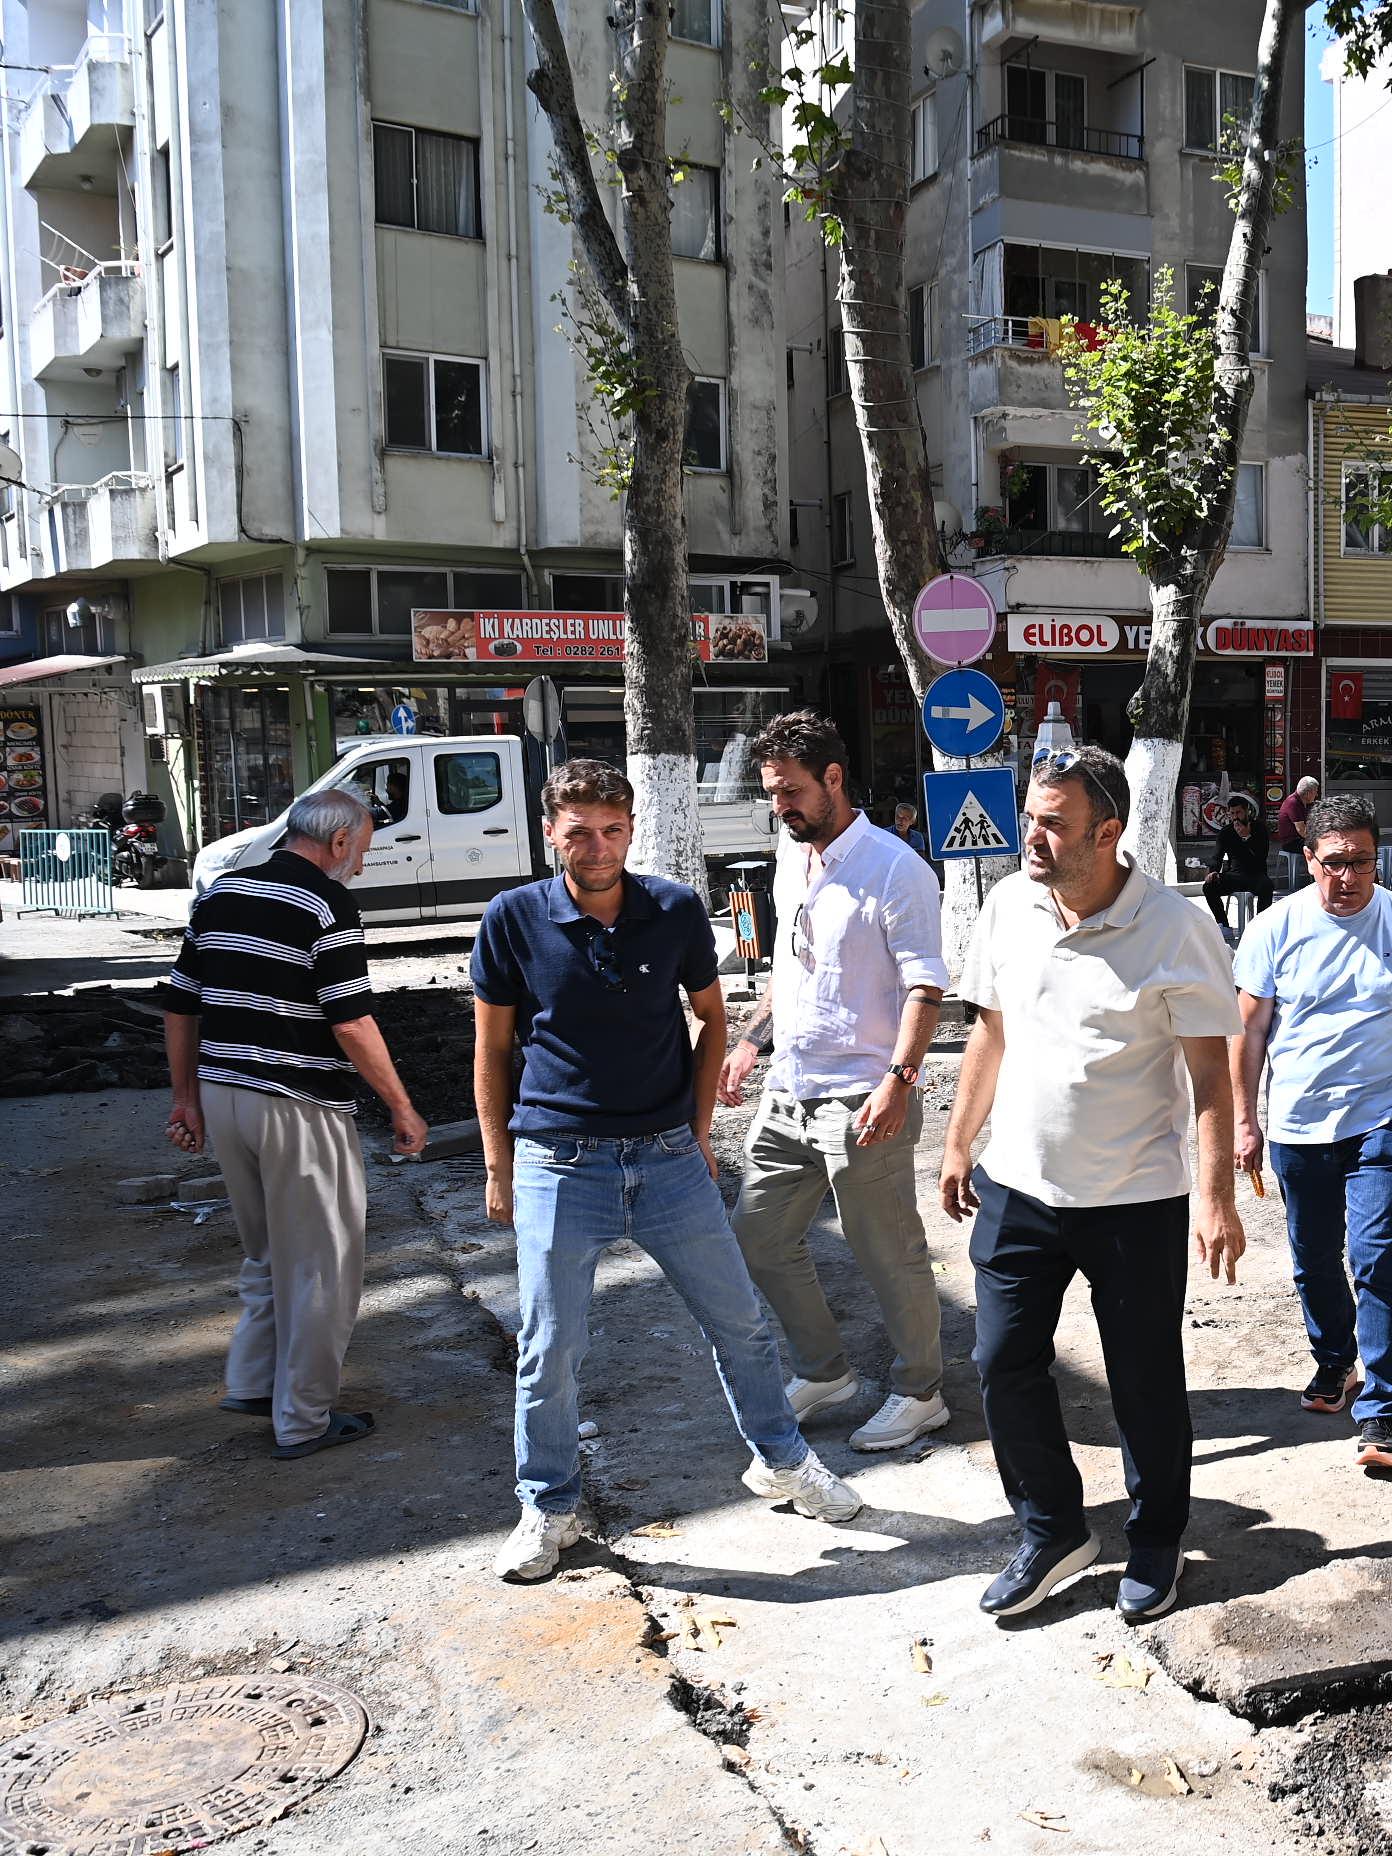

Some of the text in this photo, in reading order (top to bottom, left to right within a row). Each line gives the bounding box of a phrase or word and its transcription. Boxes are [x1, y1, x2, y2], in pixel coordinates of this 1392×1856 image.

[479, 614, 625, 642] İKİ KARDEŞLER UNLU
[1022, 618, 1317, 653] ELİBOL YEK DÜNYASI
[534, 645, 554, 657] Tel
[564, 645, 597, 657] 0282
[599, 645, 621, 657] 261
[1361, 737, 1390, 745] ERKEK
